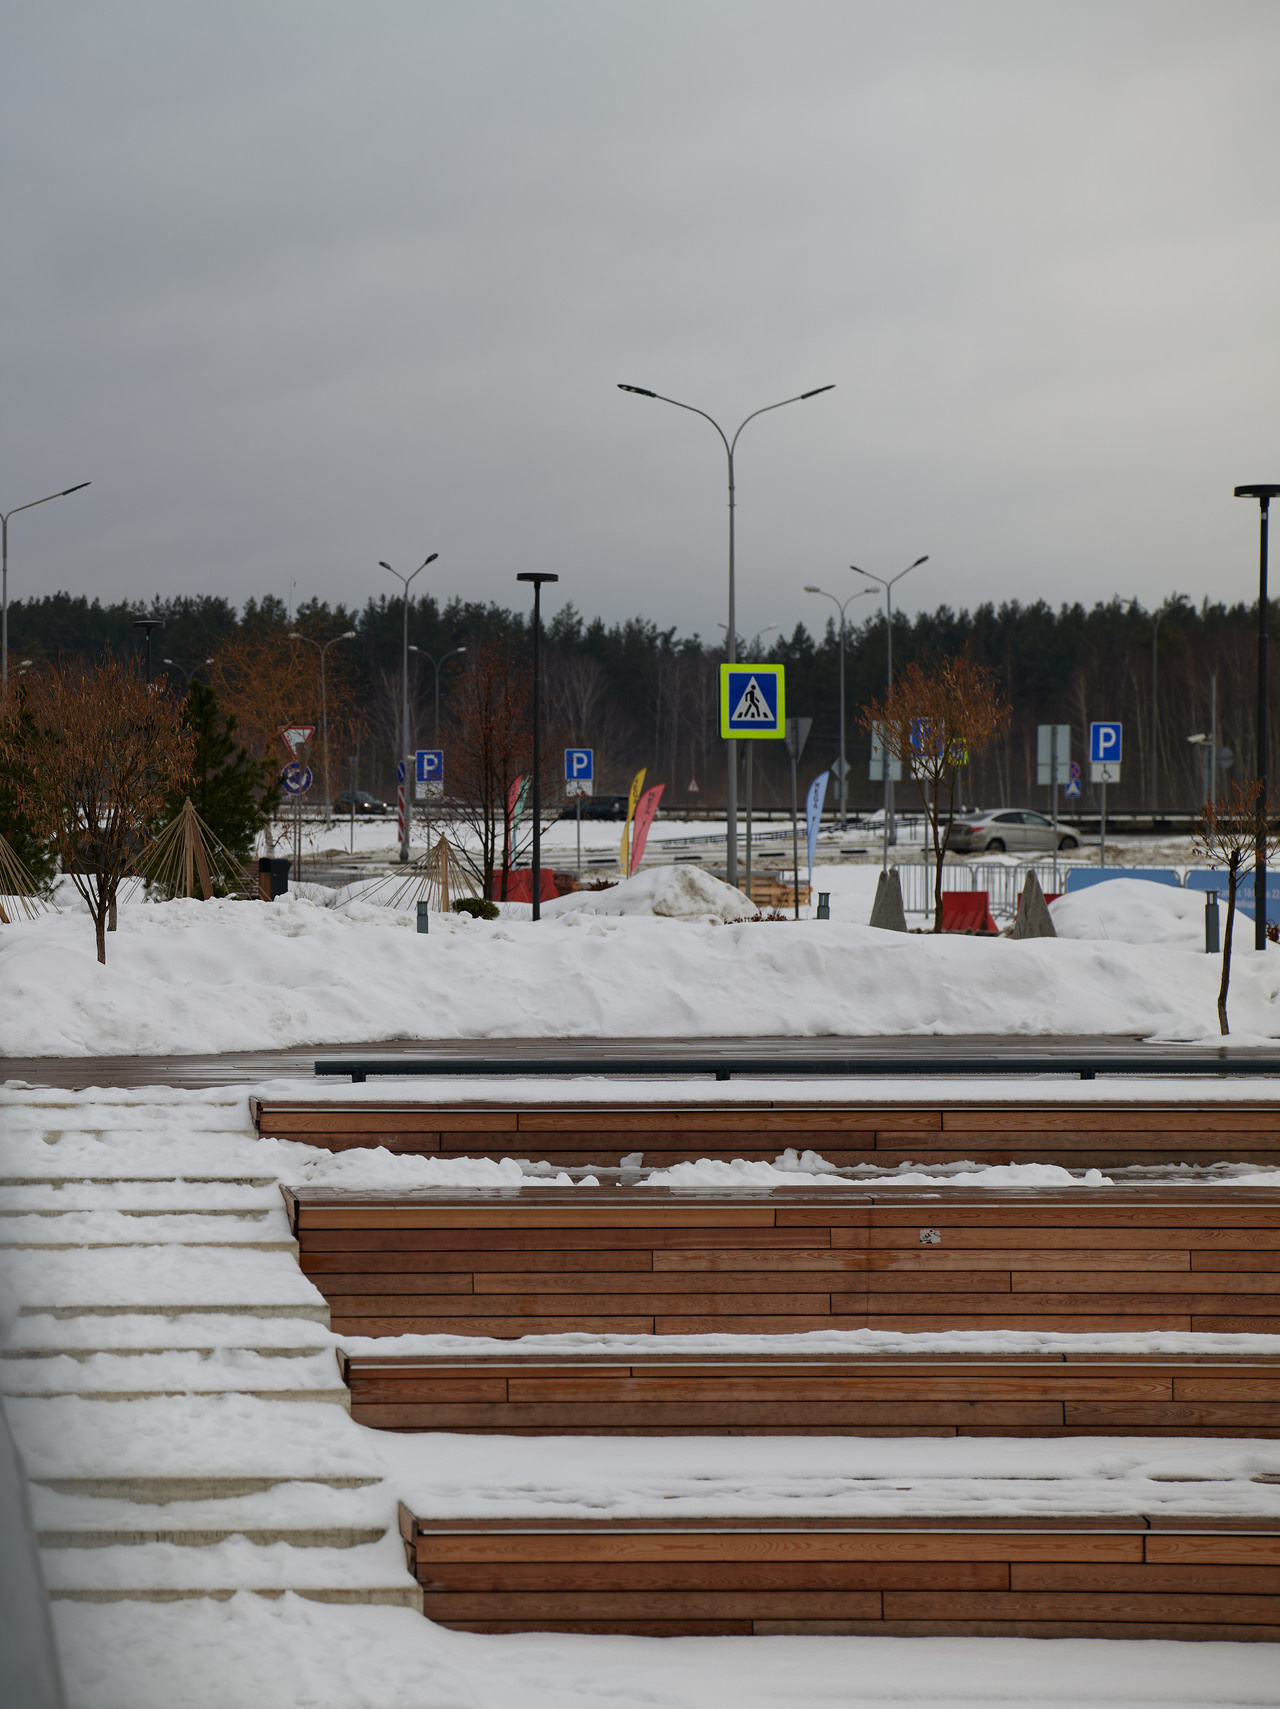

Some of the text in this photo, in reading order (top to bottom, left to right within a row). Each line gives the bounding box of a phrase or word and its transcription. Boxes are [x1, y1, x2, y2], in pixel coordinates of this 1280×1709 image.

[1099, 726, 1116, 758] P
[423, 754, 438, 779] P
[573, 752, 588, 777] P
